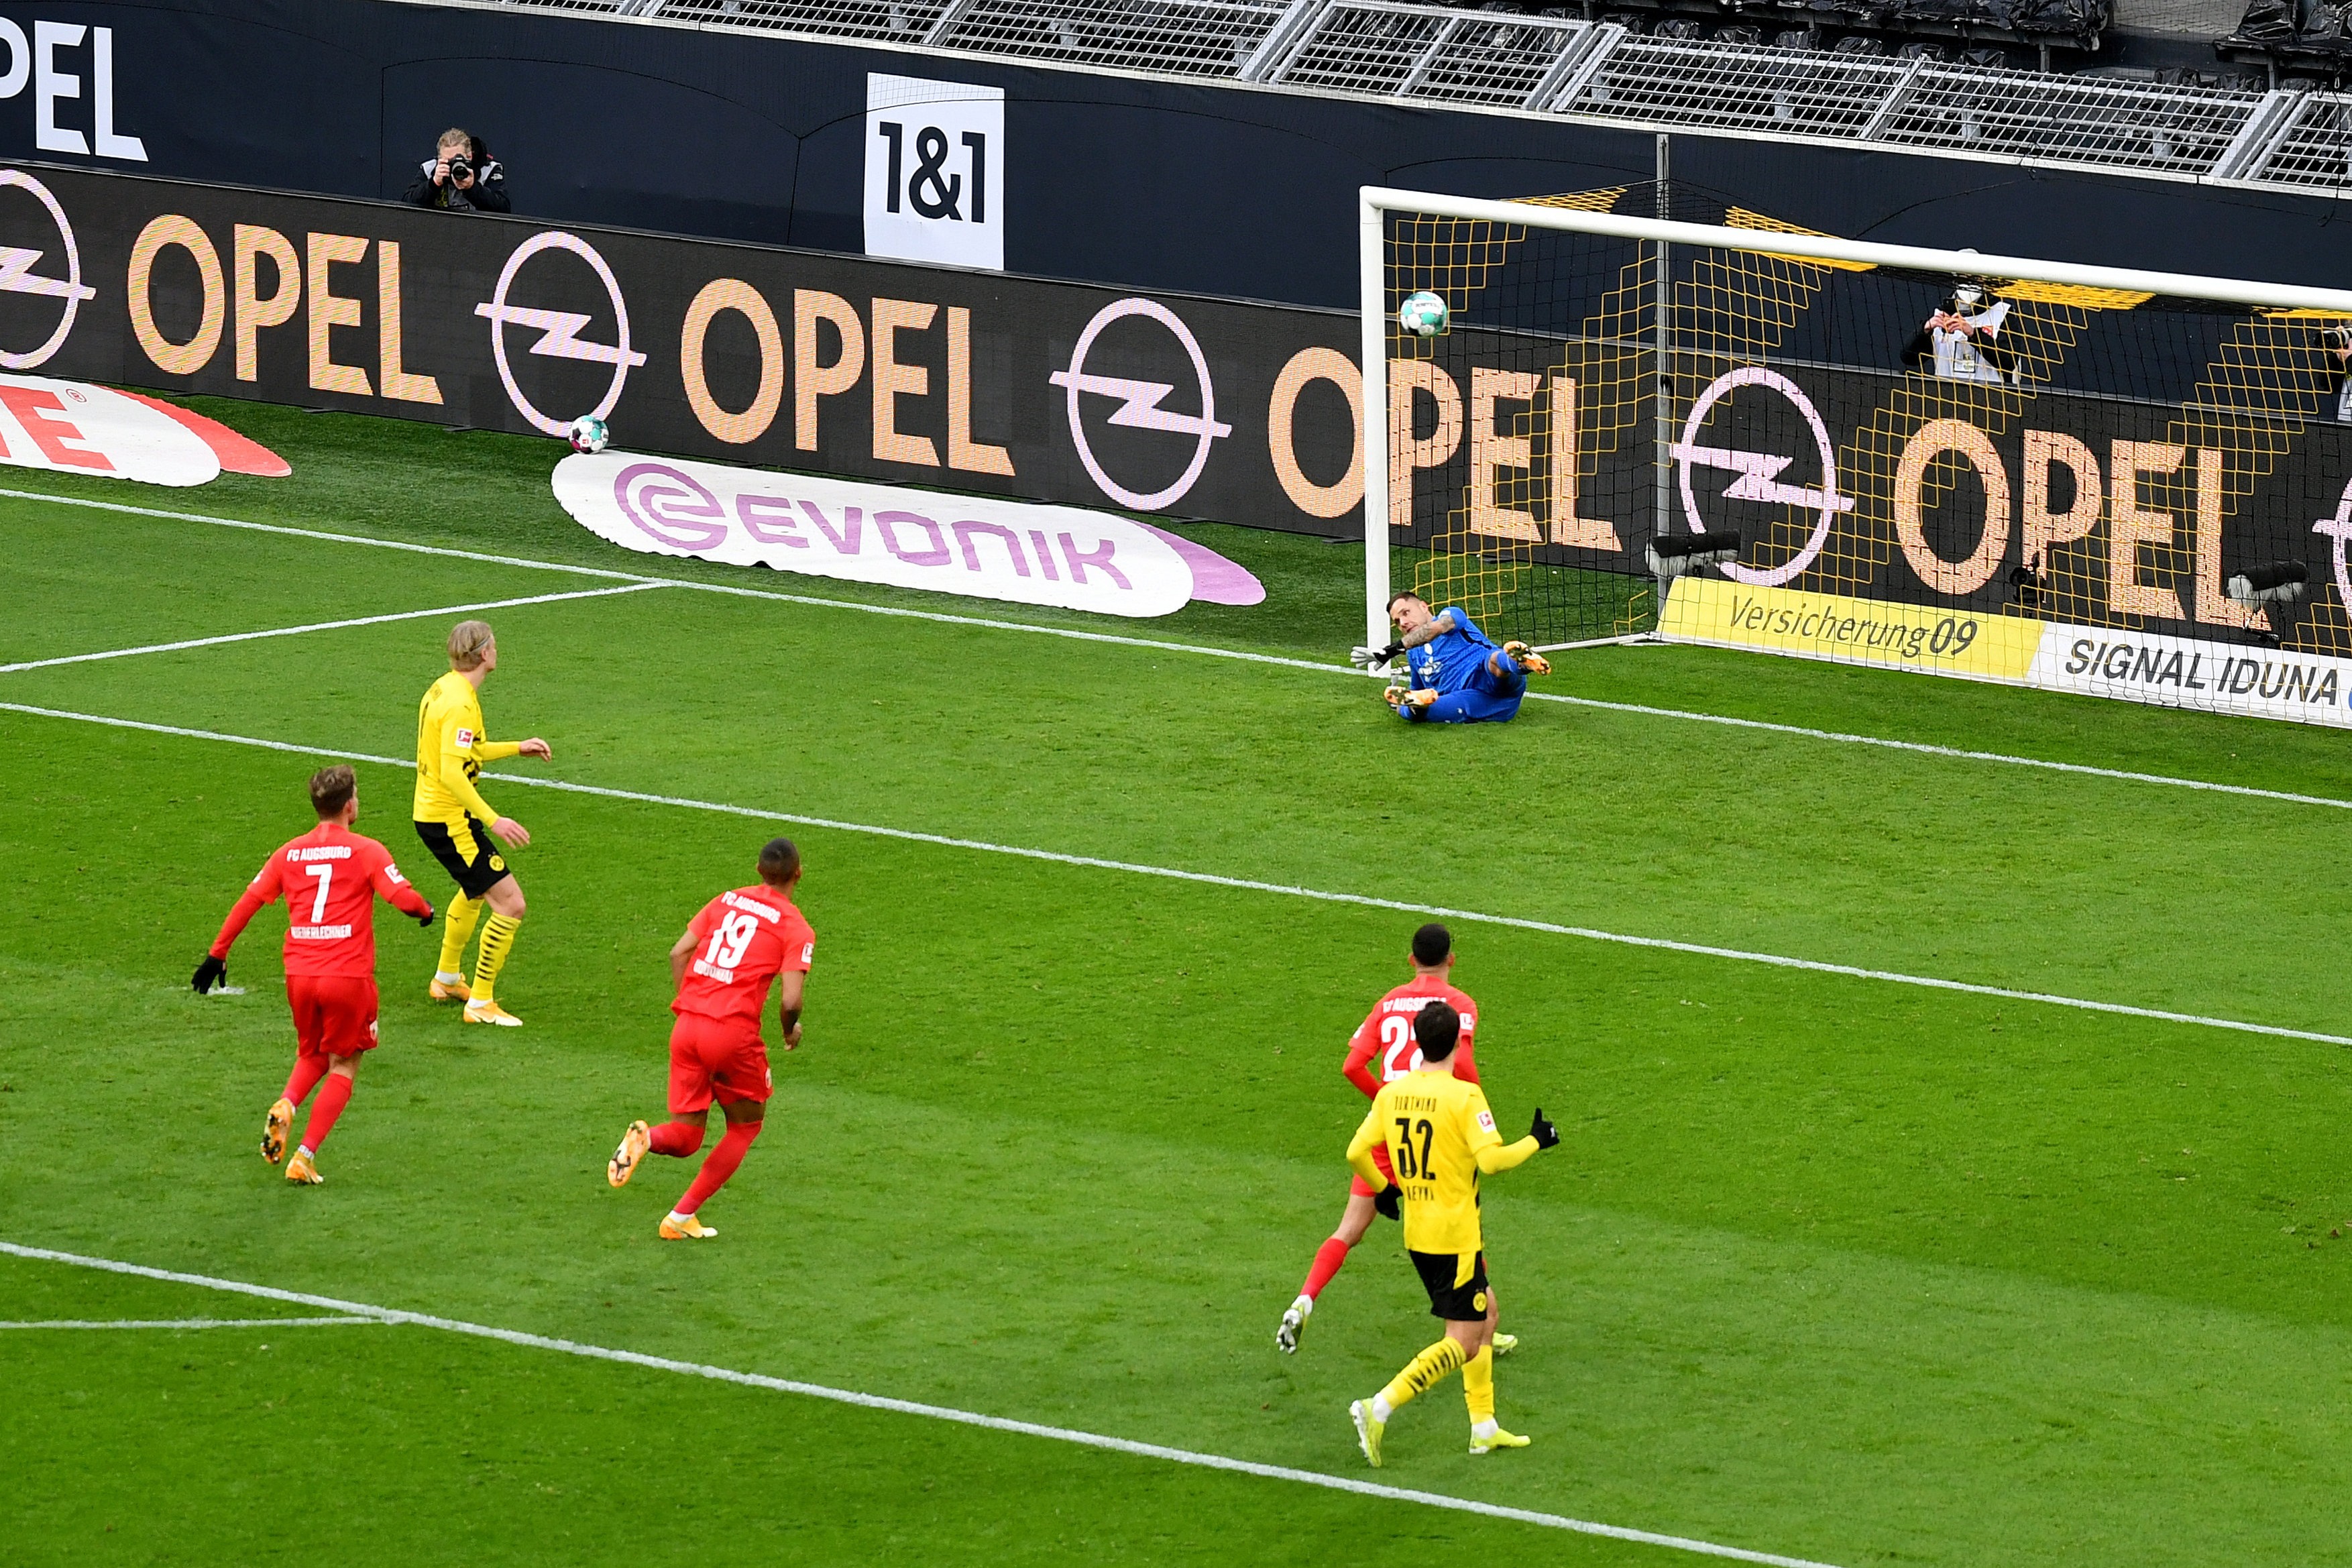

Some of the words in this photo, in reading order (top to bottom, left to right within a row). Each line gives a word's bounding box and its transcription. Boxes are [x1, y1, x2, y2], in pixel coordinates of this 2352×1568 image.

[879, 121, 986, 223] 1&1
[128, 214, 444, 405] OPEL
[681, 277, 1016, 477] OPEL
[1268, 346, 1623, 552] OPEL
[735, 494, 1133, 590] EVONIK
[1894, 418, 2273, 632] OPEL
[2066, 638, 2206, 689] SIGNAL
[2217, 657, 2339, 706] IDUNA
[305, 863, 333, 923] 7
[705, 910, 759, 969] 19
[1392, 996, 1447, 1012] AUGSB
[1395, 1118, 1436, 1180] 32
